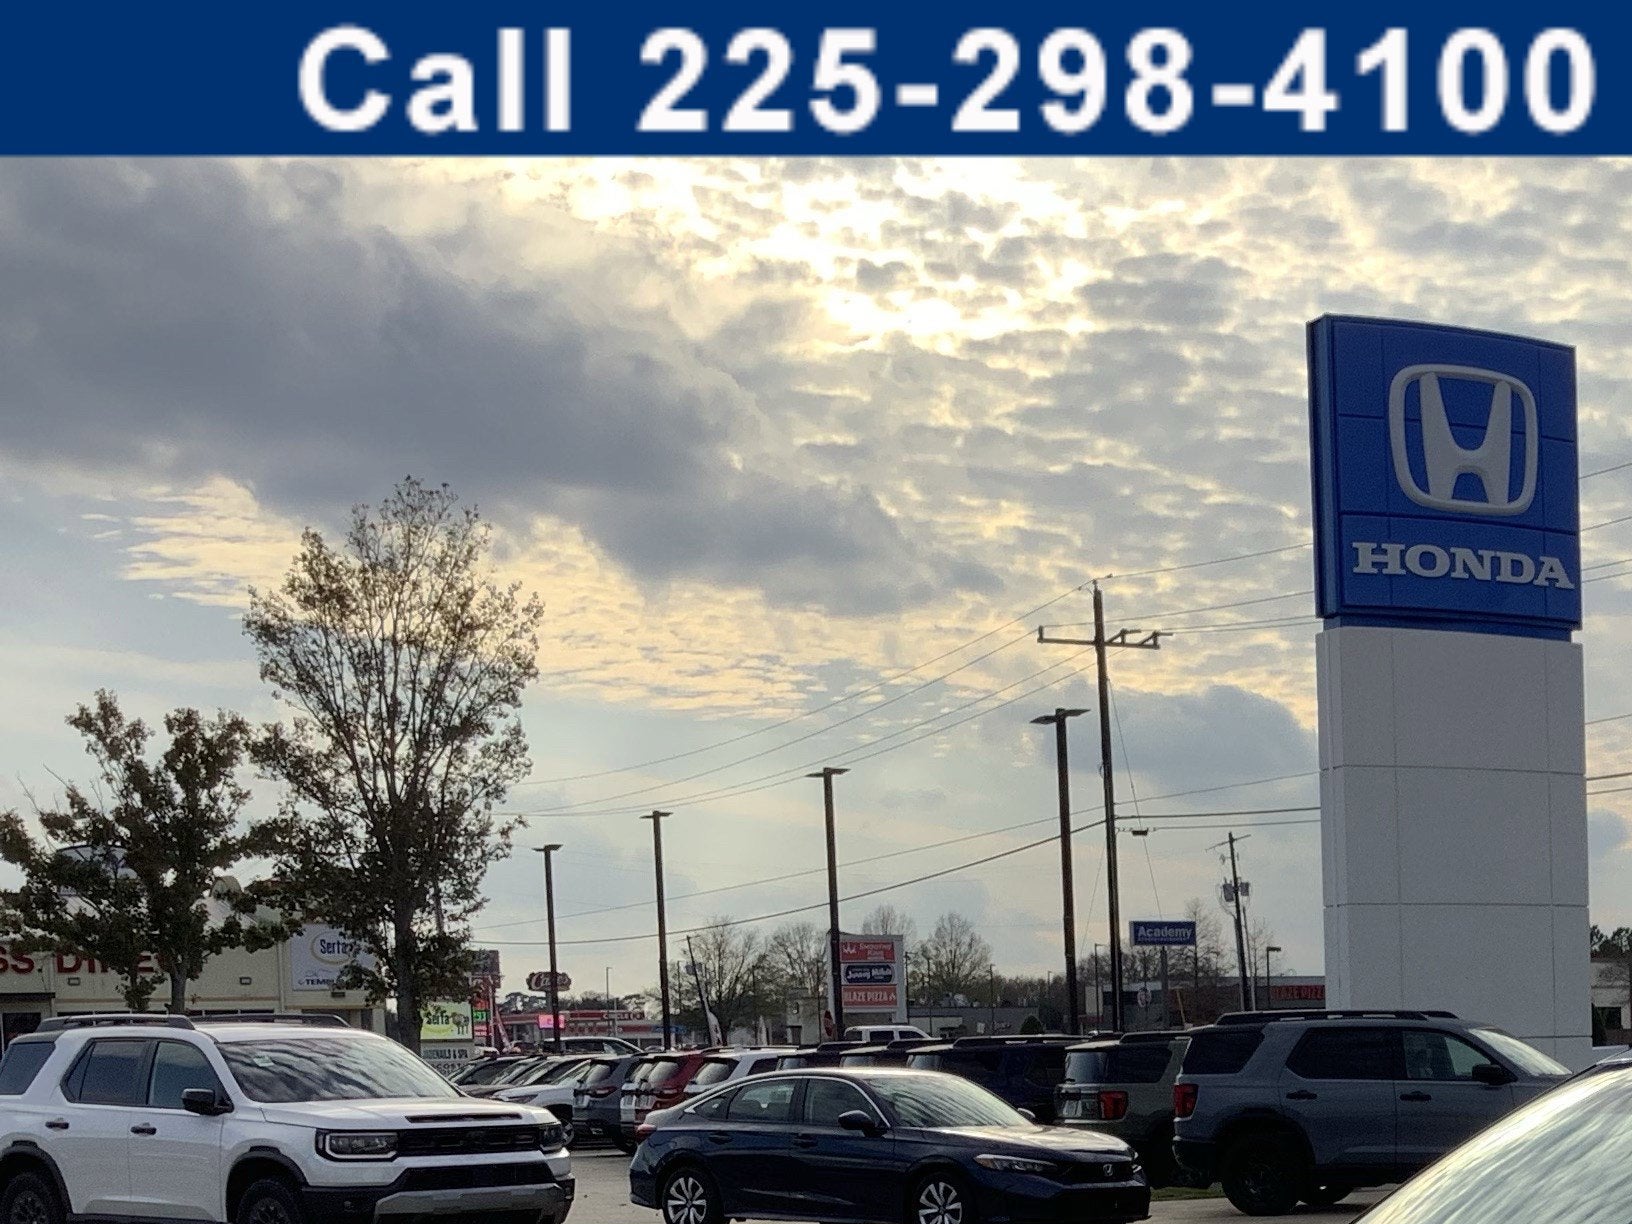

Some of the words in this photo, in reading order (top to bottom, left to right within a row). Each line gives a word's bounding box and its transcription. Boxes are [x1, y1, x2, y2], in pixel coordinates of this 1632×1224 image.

[1352, 542, 1575, 589] HONDA
[1138, 926, 1192, 940] Academy
[320, 939, 349, 955] Serta
[867, 991, 888, 1001] PIZZA
